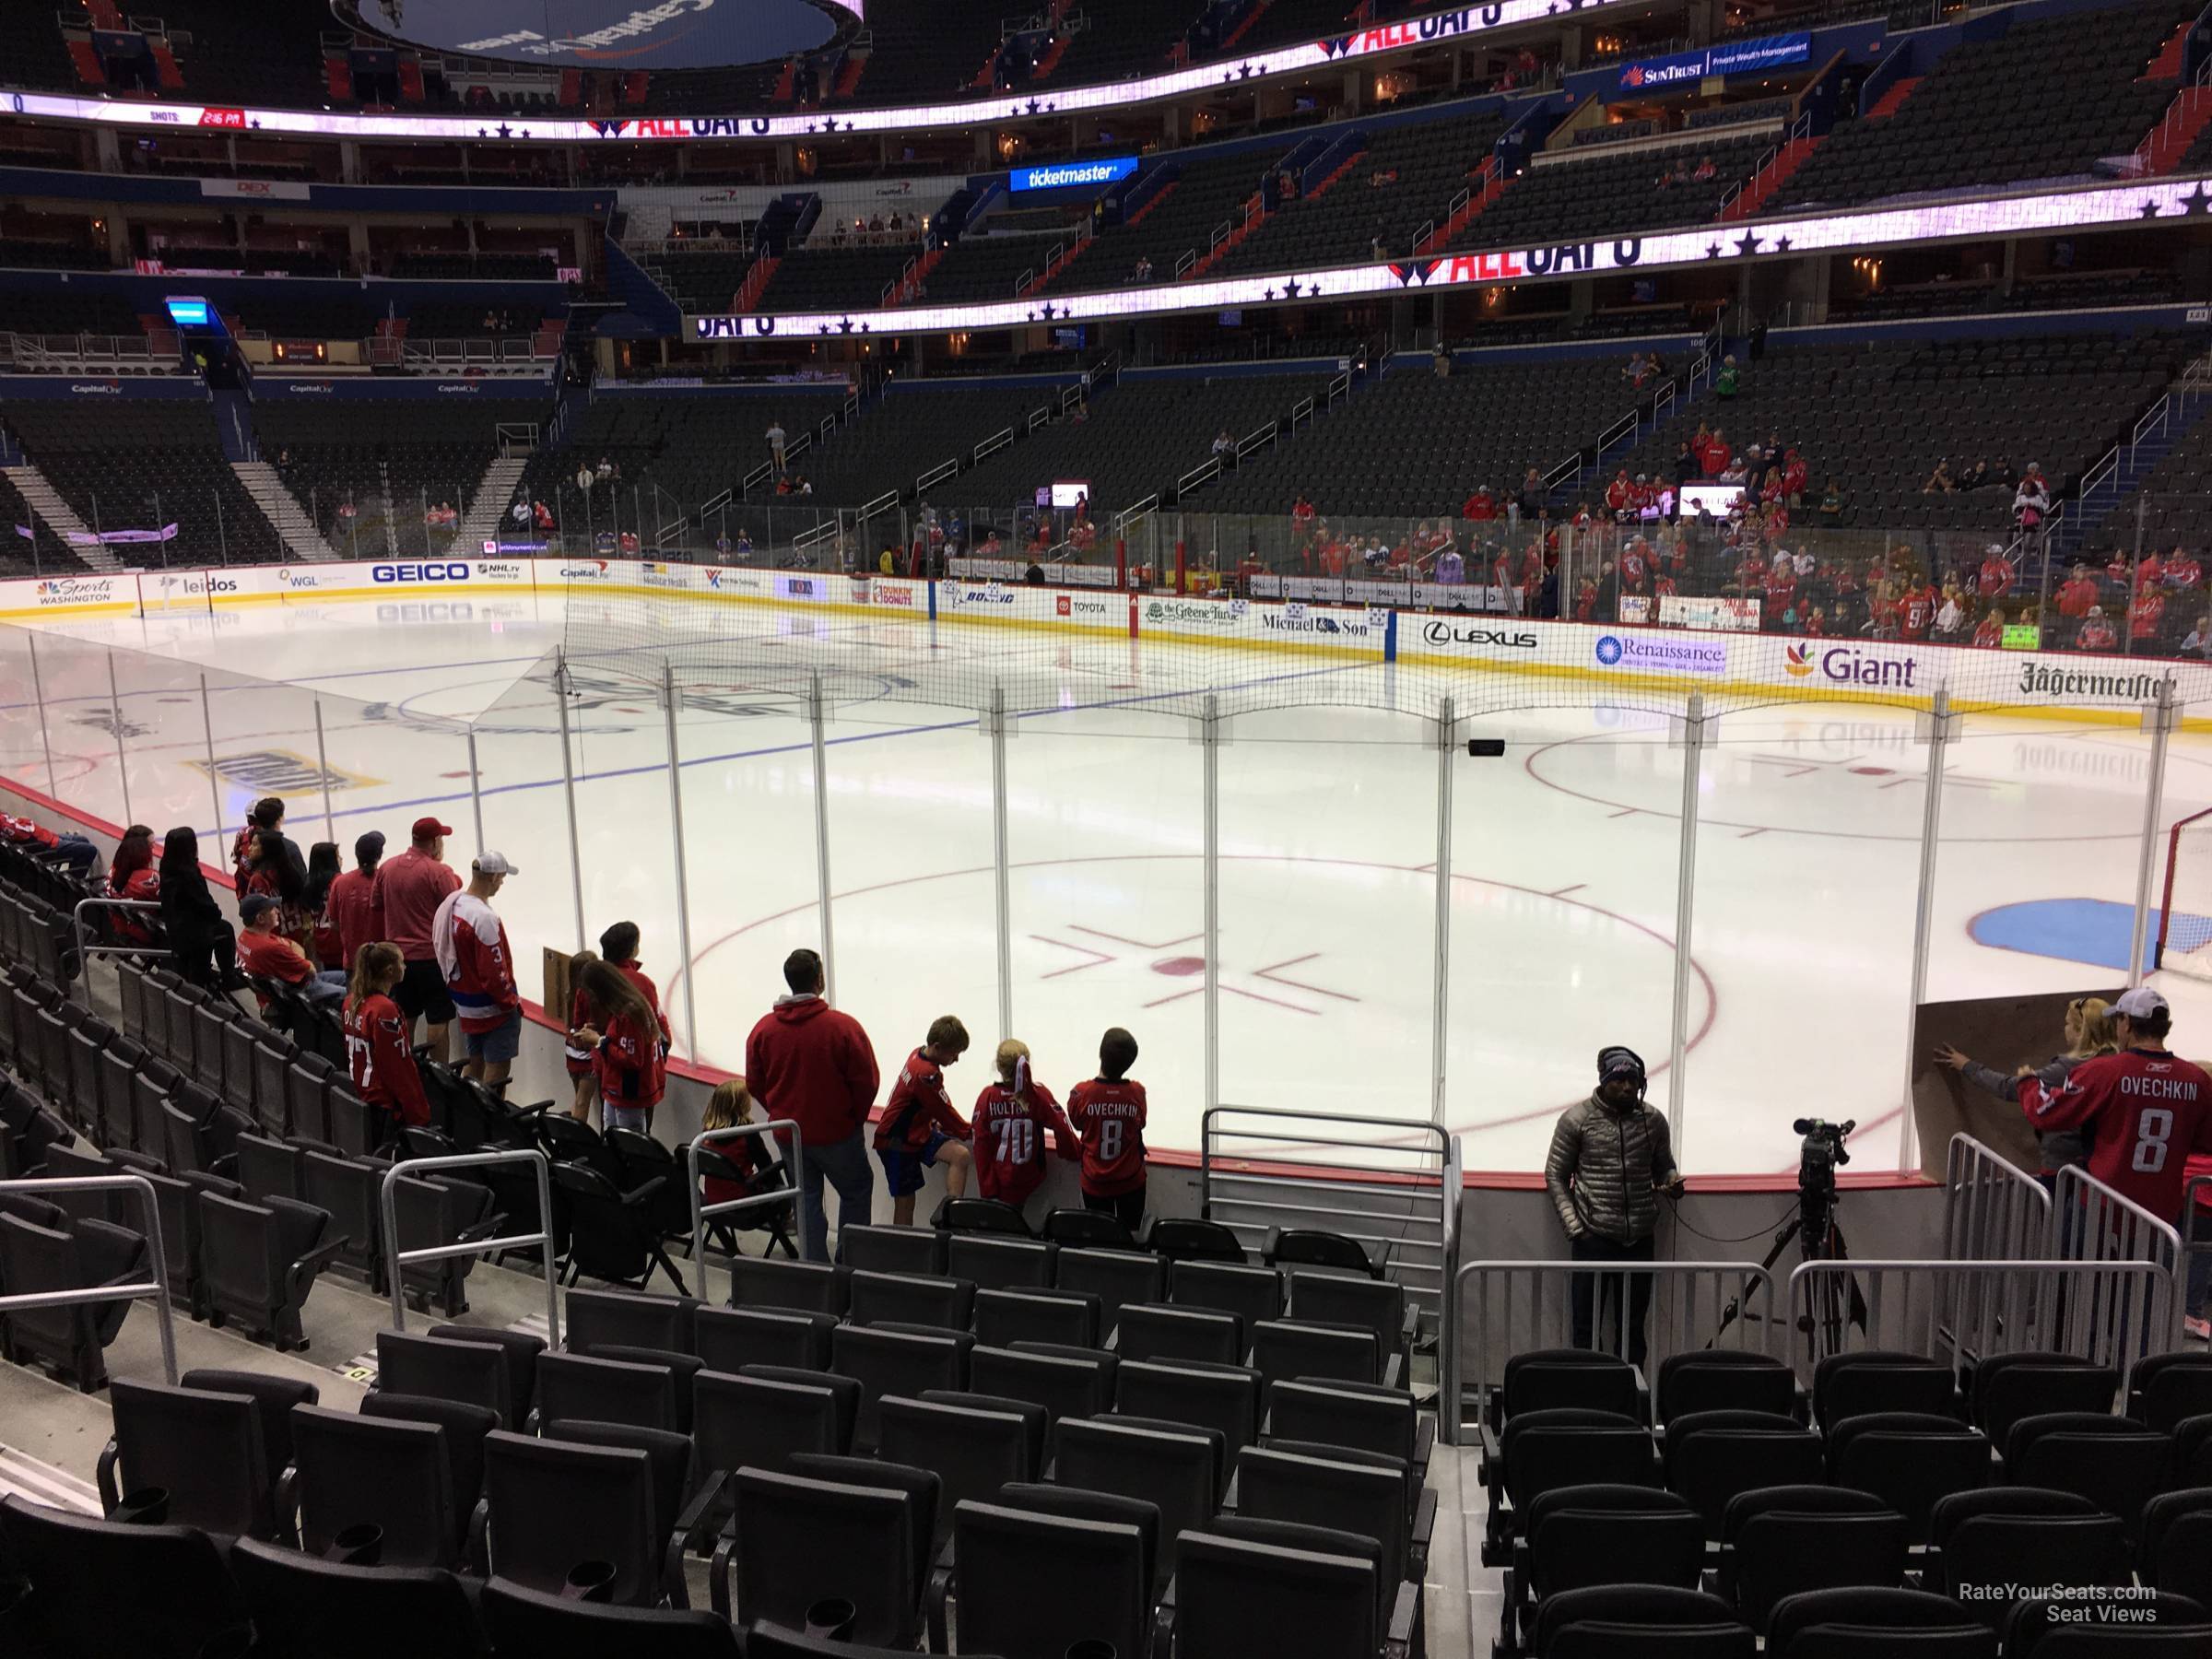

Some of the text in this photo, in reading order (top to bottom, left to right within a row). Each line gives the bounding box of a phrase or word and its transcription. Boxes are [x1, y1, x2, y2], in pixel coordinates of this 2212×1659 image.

[1712, 55, 1735, 65] Private
[1736, 51, 1760, 62] Wealth
[1761, 42, 1807, 57] Management
[1029, 165, 1114, 187] ticketmaster
[290, 576, 319, 587] WGL
[372, 563, 470, 582] GEICO
[60, 579, 114, 594] Sports
[183, 577, 238, 594] leidos
[41, 594, 111, 605] WASHINGTON
[883, 594, 912, 606] DONUTS
[967, 591, 1015, 604] BONG
[1074, 602, 1106, 614] TOYOTA
[1175, 604, 1209, 619] Greene
[1210, 606, 1239, 620] Ture
[1263, 613, 1313, 632] Michael
[1342, 619, 1368, 635] Son
[1453, 629, 1537, 647] LEXUS
[1822, 647, 1917, 688] Giant
[490, 946, 503, 964] 3
[345, 1033, 373, 1088] 77
[2121, 1076, 2199, 1101] OVECHKIN
[989, 1101, 1030, 1117] HOLTB
[1088, 1103, 1138, 1118] OVECHKIN
[990, 1118, 1034, 1165] 70
[1100, 1119, 1124, 1160] 8
[2131, 1108, 2173, 1173] 8
